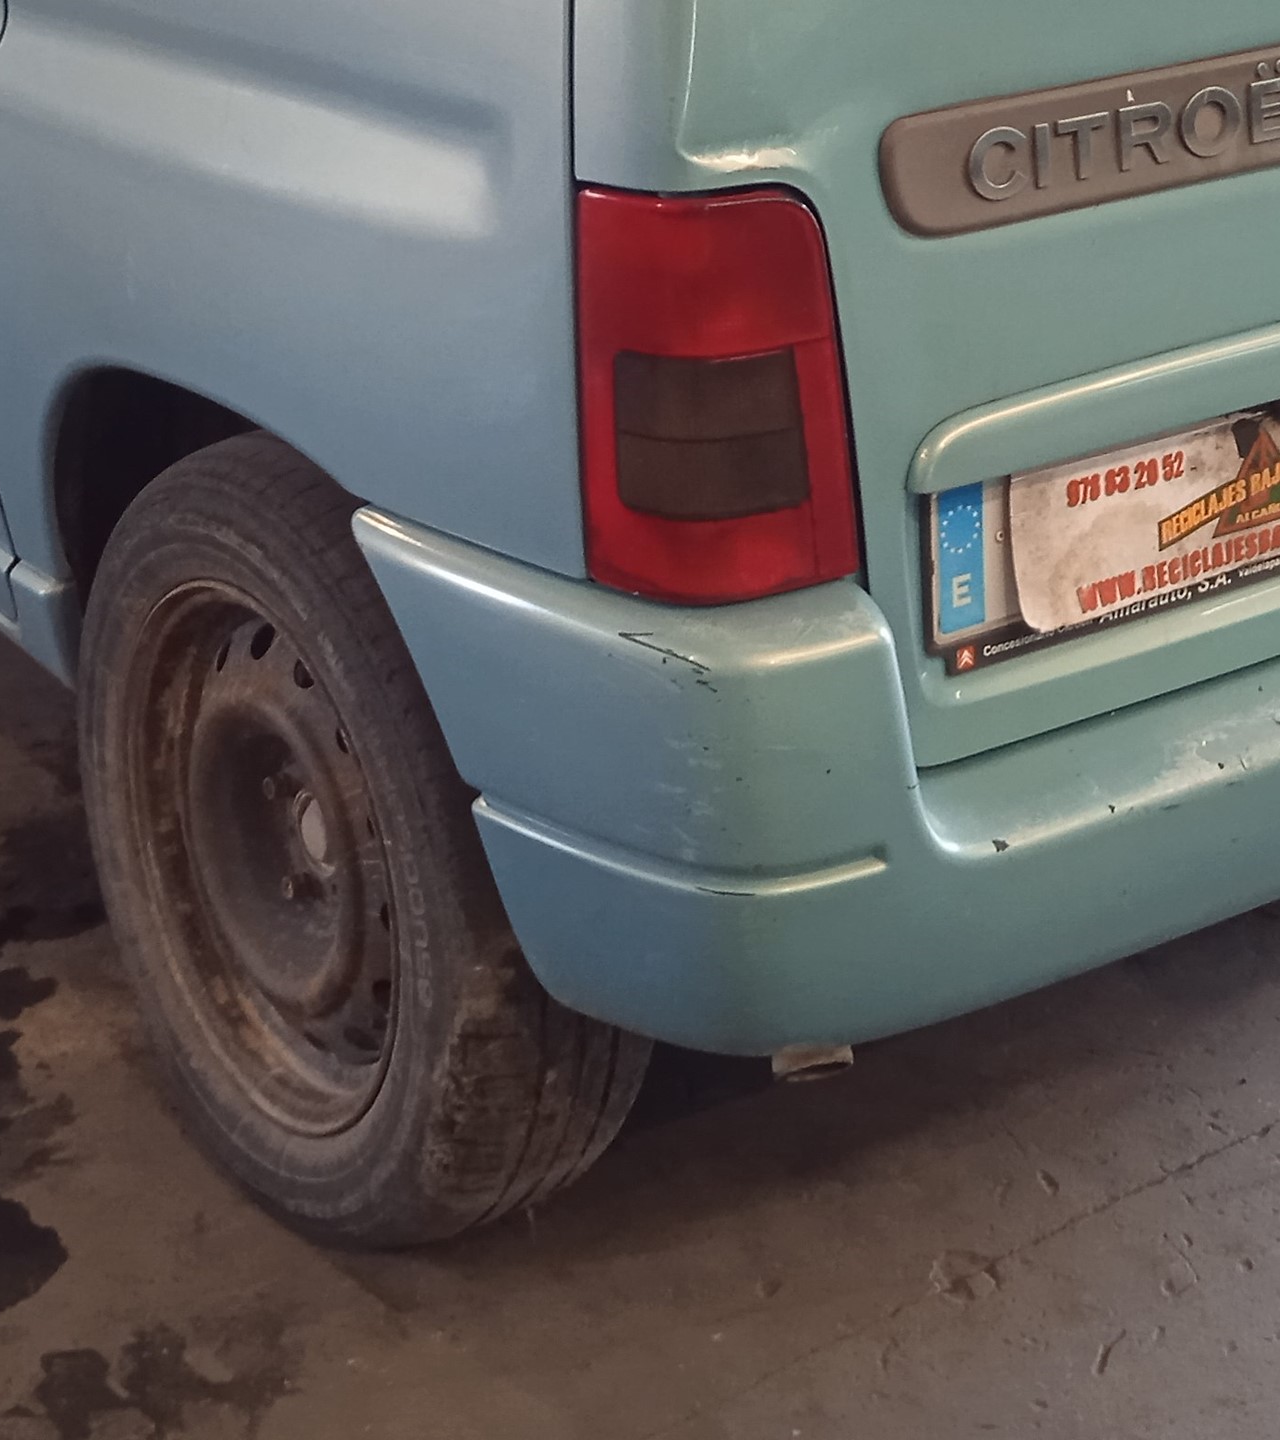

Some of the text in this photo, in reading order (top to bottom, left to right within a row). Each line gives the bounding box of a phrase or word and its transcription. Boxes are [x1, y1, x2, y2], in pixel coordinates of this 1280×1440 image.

[1133, 458, 1159, 490] 20
[1161, 450, 1185, 482] 52
[1160, 478, 1247, 544] RECICLAJES
[951, 573, 972, 609] E
